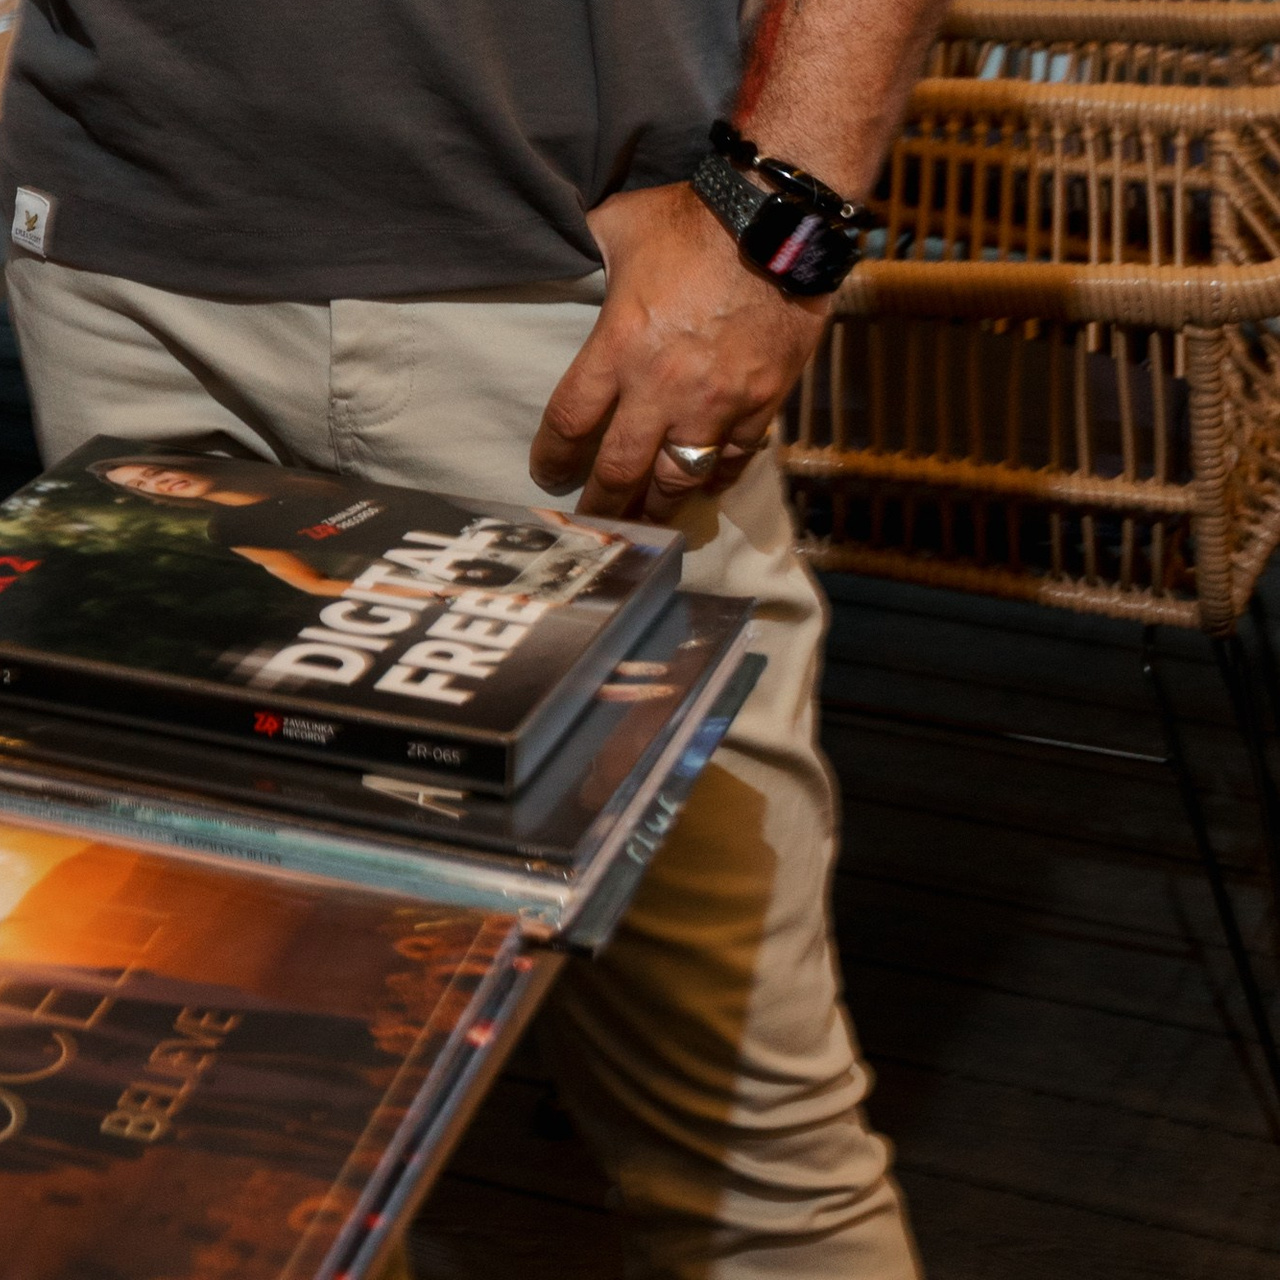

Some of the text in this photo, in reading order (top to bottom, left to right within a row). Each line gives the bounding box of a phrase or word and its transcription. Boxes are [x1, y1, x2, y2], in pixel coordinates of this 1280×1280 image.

[262, 525, 505, 686] DIGITAL
[374, 589, 549, 706] FREE
[2, 668, 12, 685] 2
[282, 716, 336, 736] ZAVALINKA
[282, 727, 327, 745] RECORDS
[406, 741, 462, 765] ZR-065
